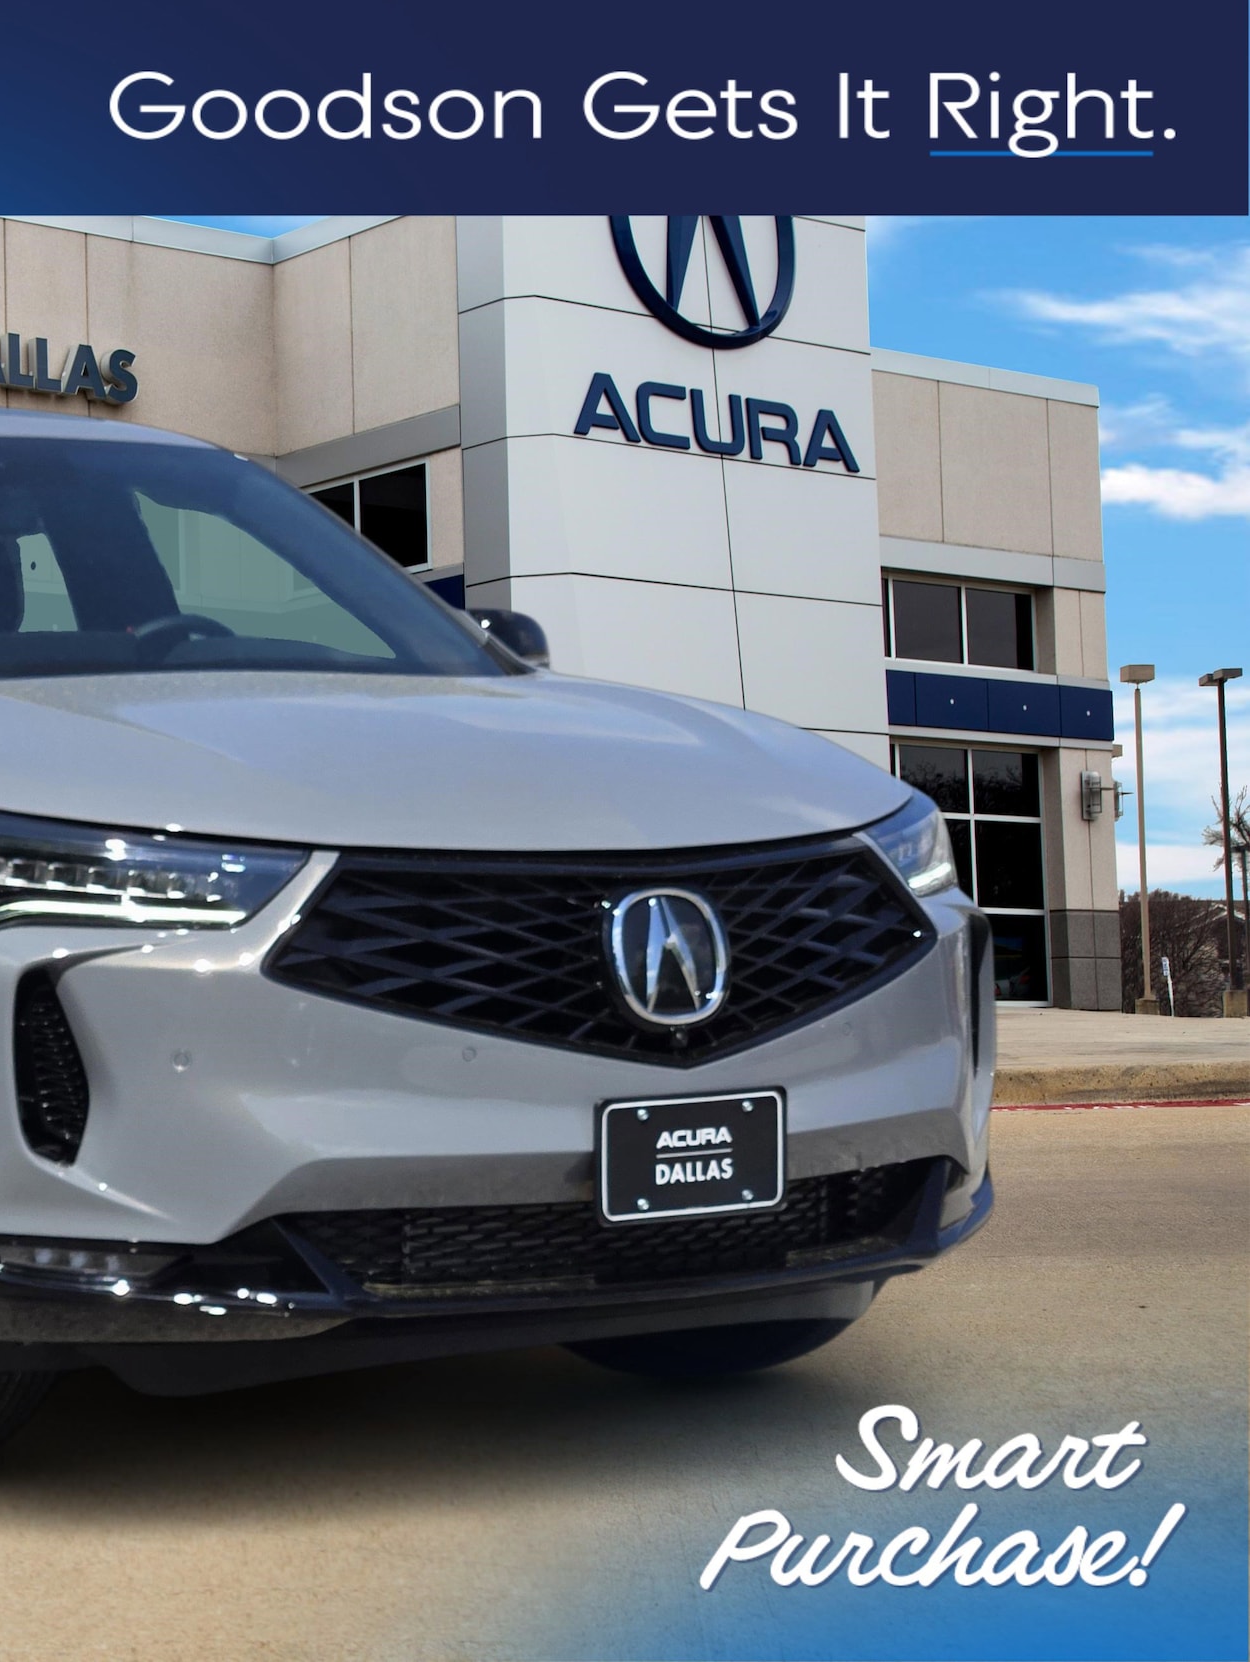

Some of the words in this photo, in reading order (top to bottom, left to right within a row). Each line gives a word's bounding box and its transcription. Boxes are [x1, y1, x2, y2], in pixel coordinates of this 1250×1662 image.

[574, 372, 861, 474] ACURA
[656, 1126, 733, 1149] ACURA
[655, 1158, 734, 1186] DALLAS
